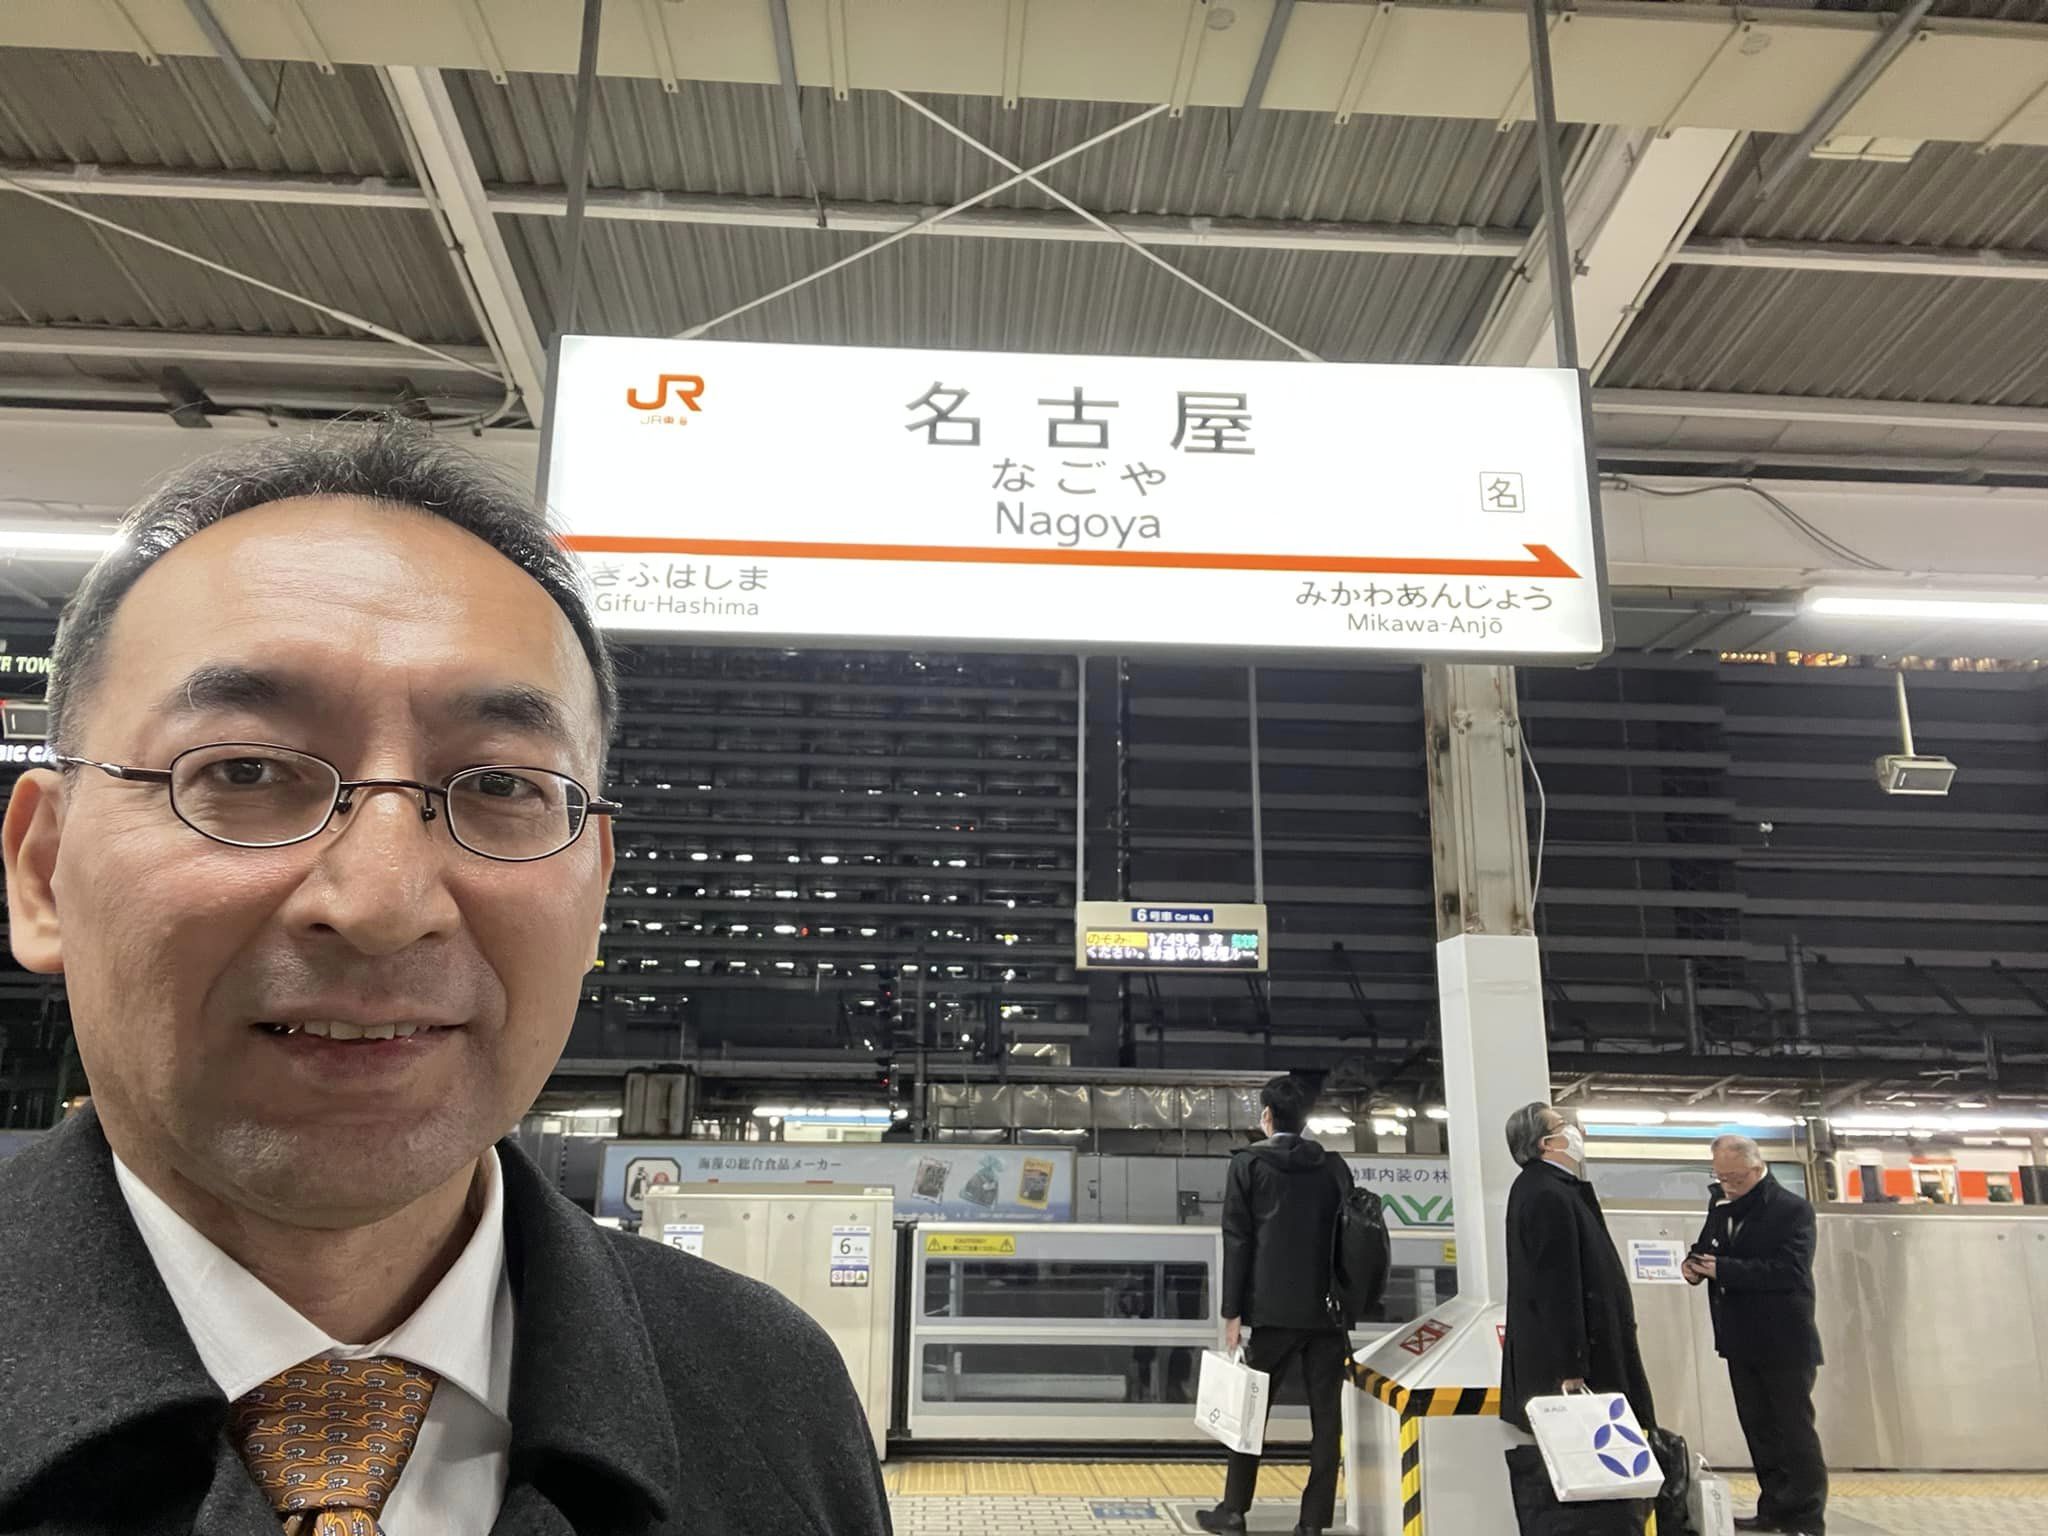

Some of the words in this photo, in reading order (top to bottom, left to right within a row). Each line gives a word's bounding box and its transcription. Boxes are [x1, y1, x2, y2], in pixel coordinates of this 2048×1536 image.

[627, 374, 704, 411] JR
[904, 380, 1256, 455] 名古屋
[991, 457, 1167, 497] なごや
[1487, 477, 1518, 509] 名
[995, 500, 1161, 549] Nagoya
[595, 592, 760, 617] Gifu-Hashima
[1295, 580, 1553, 612] みかわあんじょう
[1347, 613, 1504, 639] Mikawa-Anjō
[840, 1238, 851, 1255] 6
